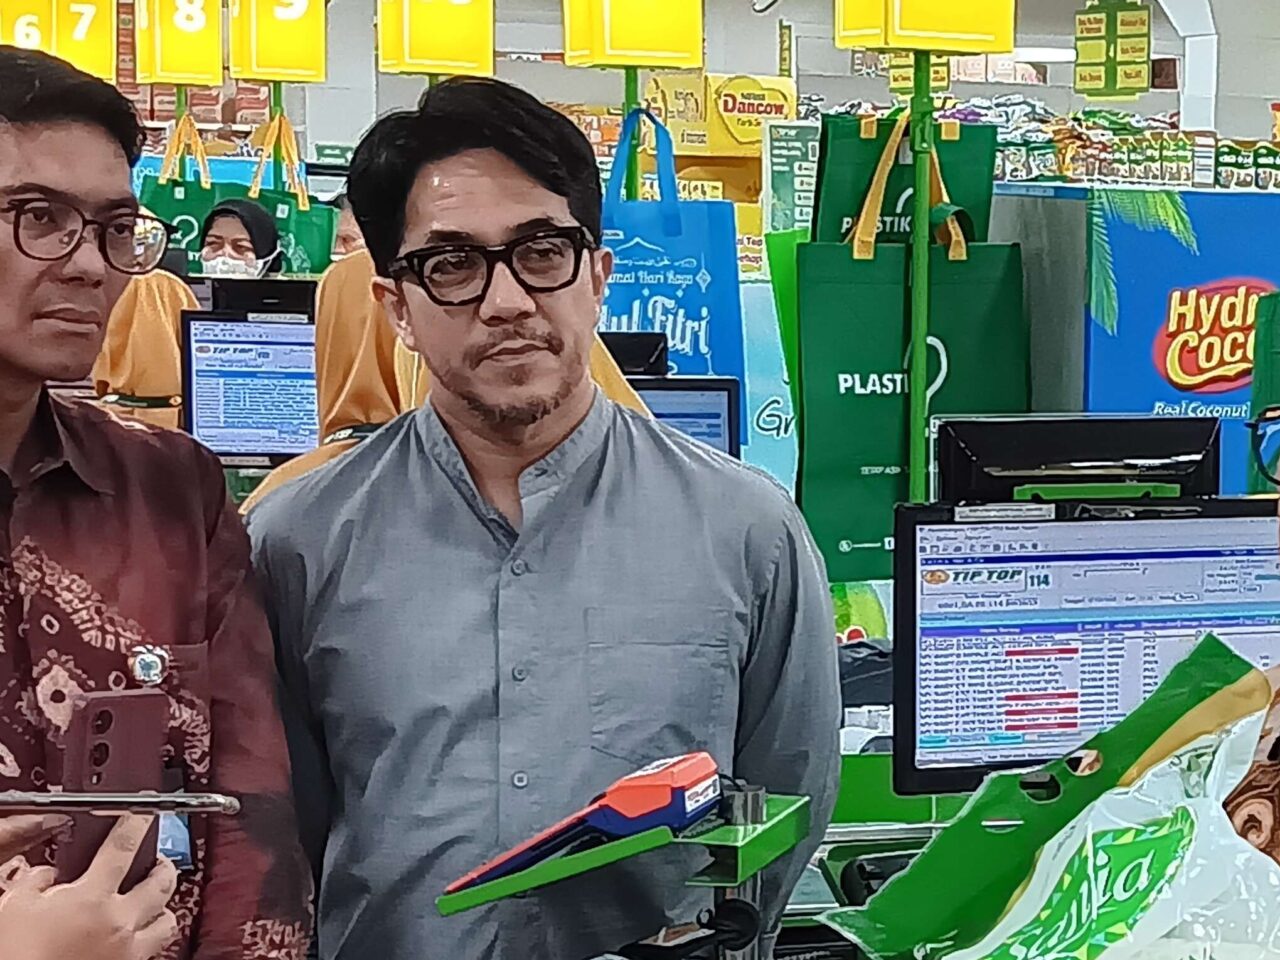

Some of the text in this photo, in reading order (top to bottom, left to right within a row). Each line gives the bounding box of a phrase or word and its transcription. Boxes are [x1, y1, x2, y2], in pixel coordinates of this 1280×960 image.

[13, 14, 42, 49] 6
[69, 3, 97, 41] 7
[722, 93, 785, 114] Dancow
[840, 215, 911, 234] PSTIK
[1168, 285, 1259, 336] Hydr
[837, 373, 909, 394] PLASTI
[1154, 401, 1248, 418] Real Coconut
